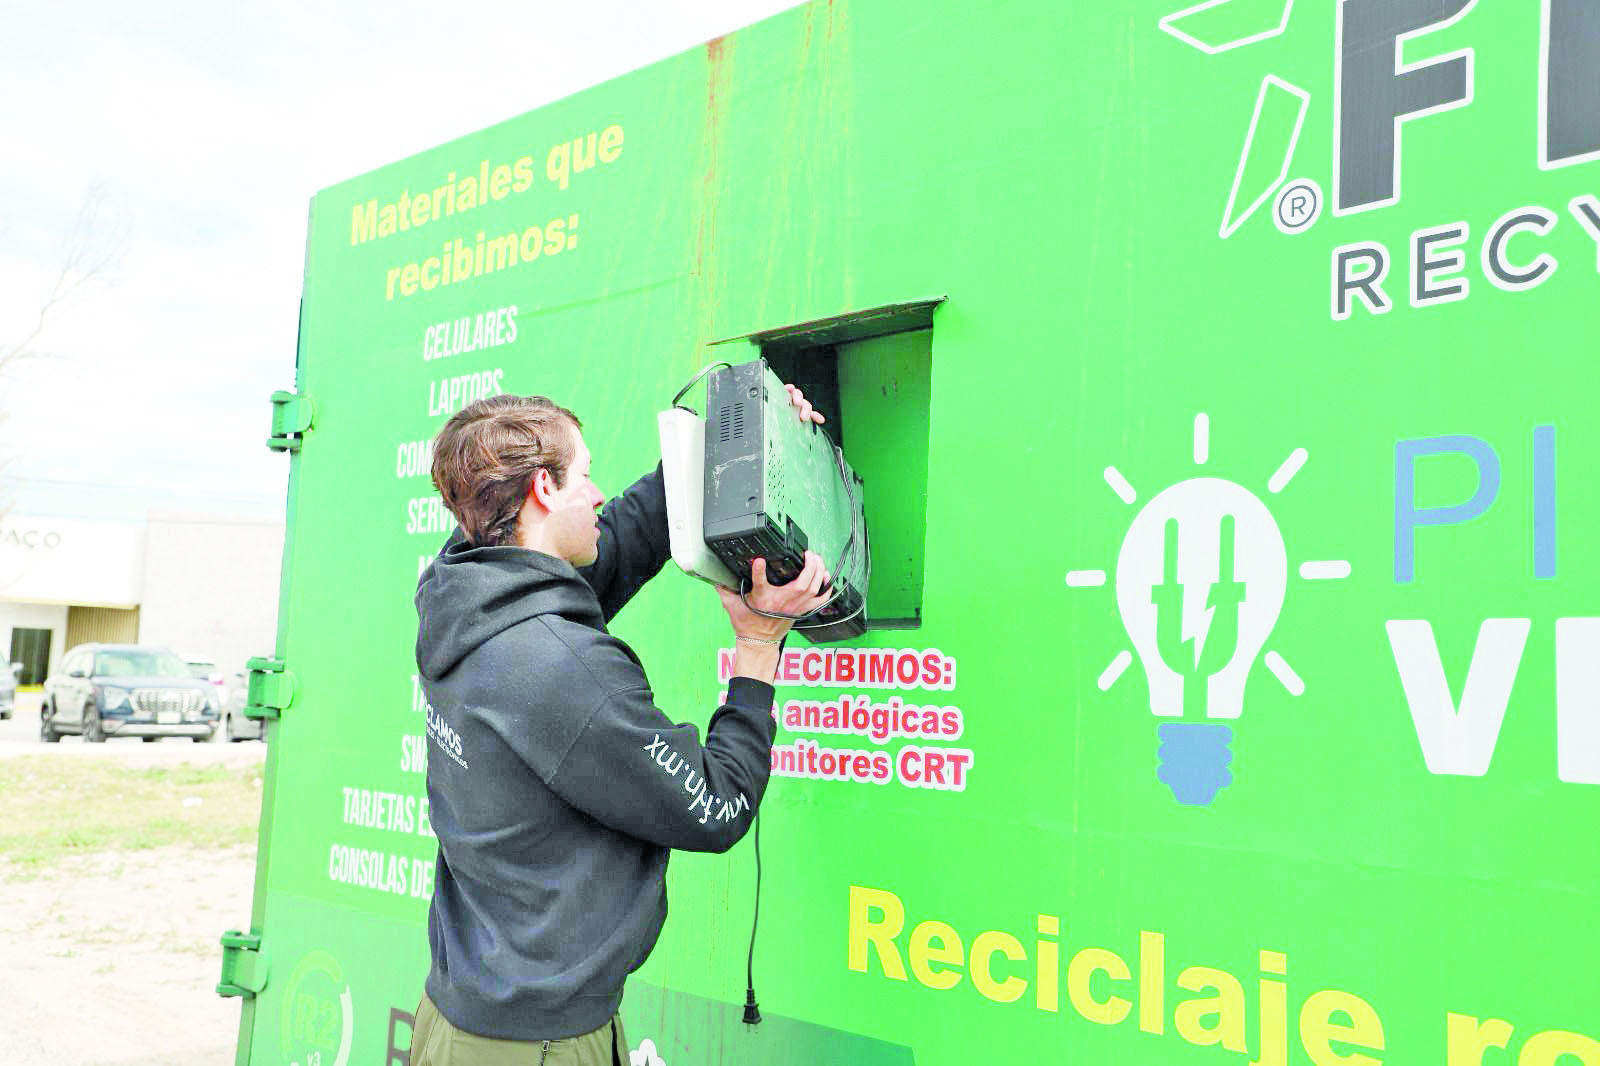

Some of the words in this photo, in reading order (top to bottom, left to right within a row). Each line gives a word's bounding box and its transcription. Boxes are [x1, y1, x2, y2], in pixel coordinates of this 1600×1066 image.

[350, 155, 534, 246] Materiales
[546, 123, 625, 190] que
[385, 213, 579, 301] recibimos:
[423, 305, 518, 361] CELULARES
[428, 368, 504, 417] LAPTOPS
[775, 652, 952, 685] ECIBIMOS:
[785, 700, 960, 739] analógicas
[900, 751, 969, 786] CRT
[342, 786, 416, 834] TARJETAS
[418, 797, 438, 837] E
[328, 843, 409, 896] CONSOLAS
[410, 857, 434, 900] DE
[847, 885, 1386, 1066] Reciclaje
